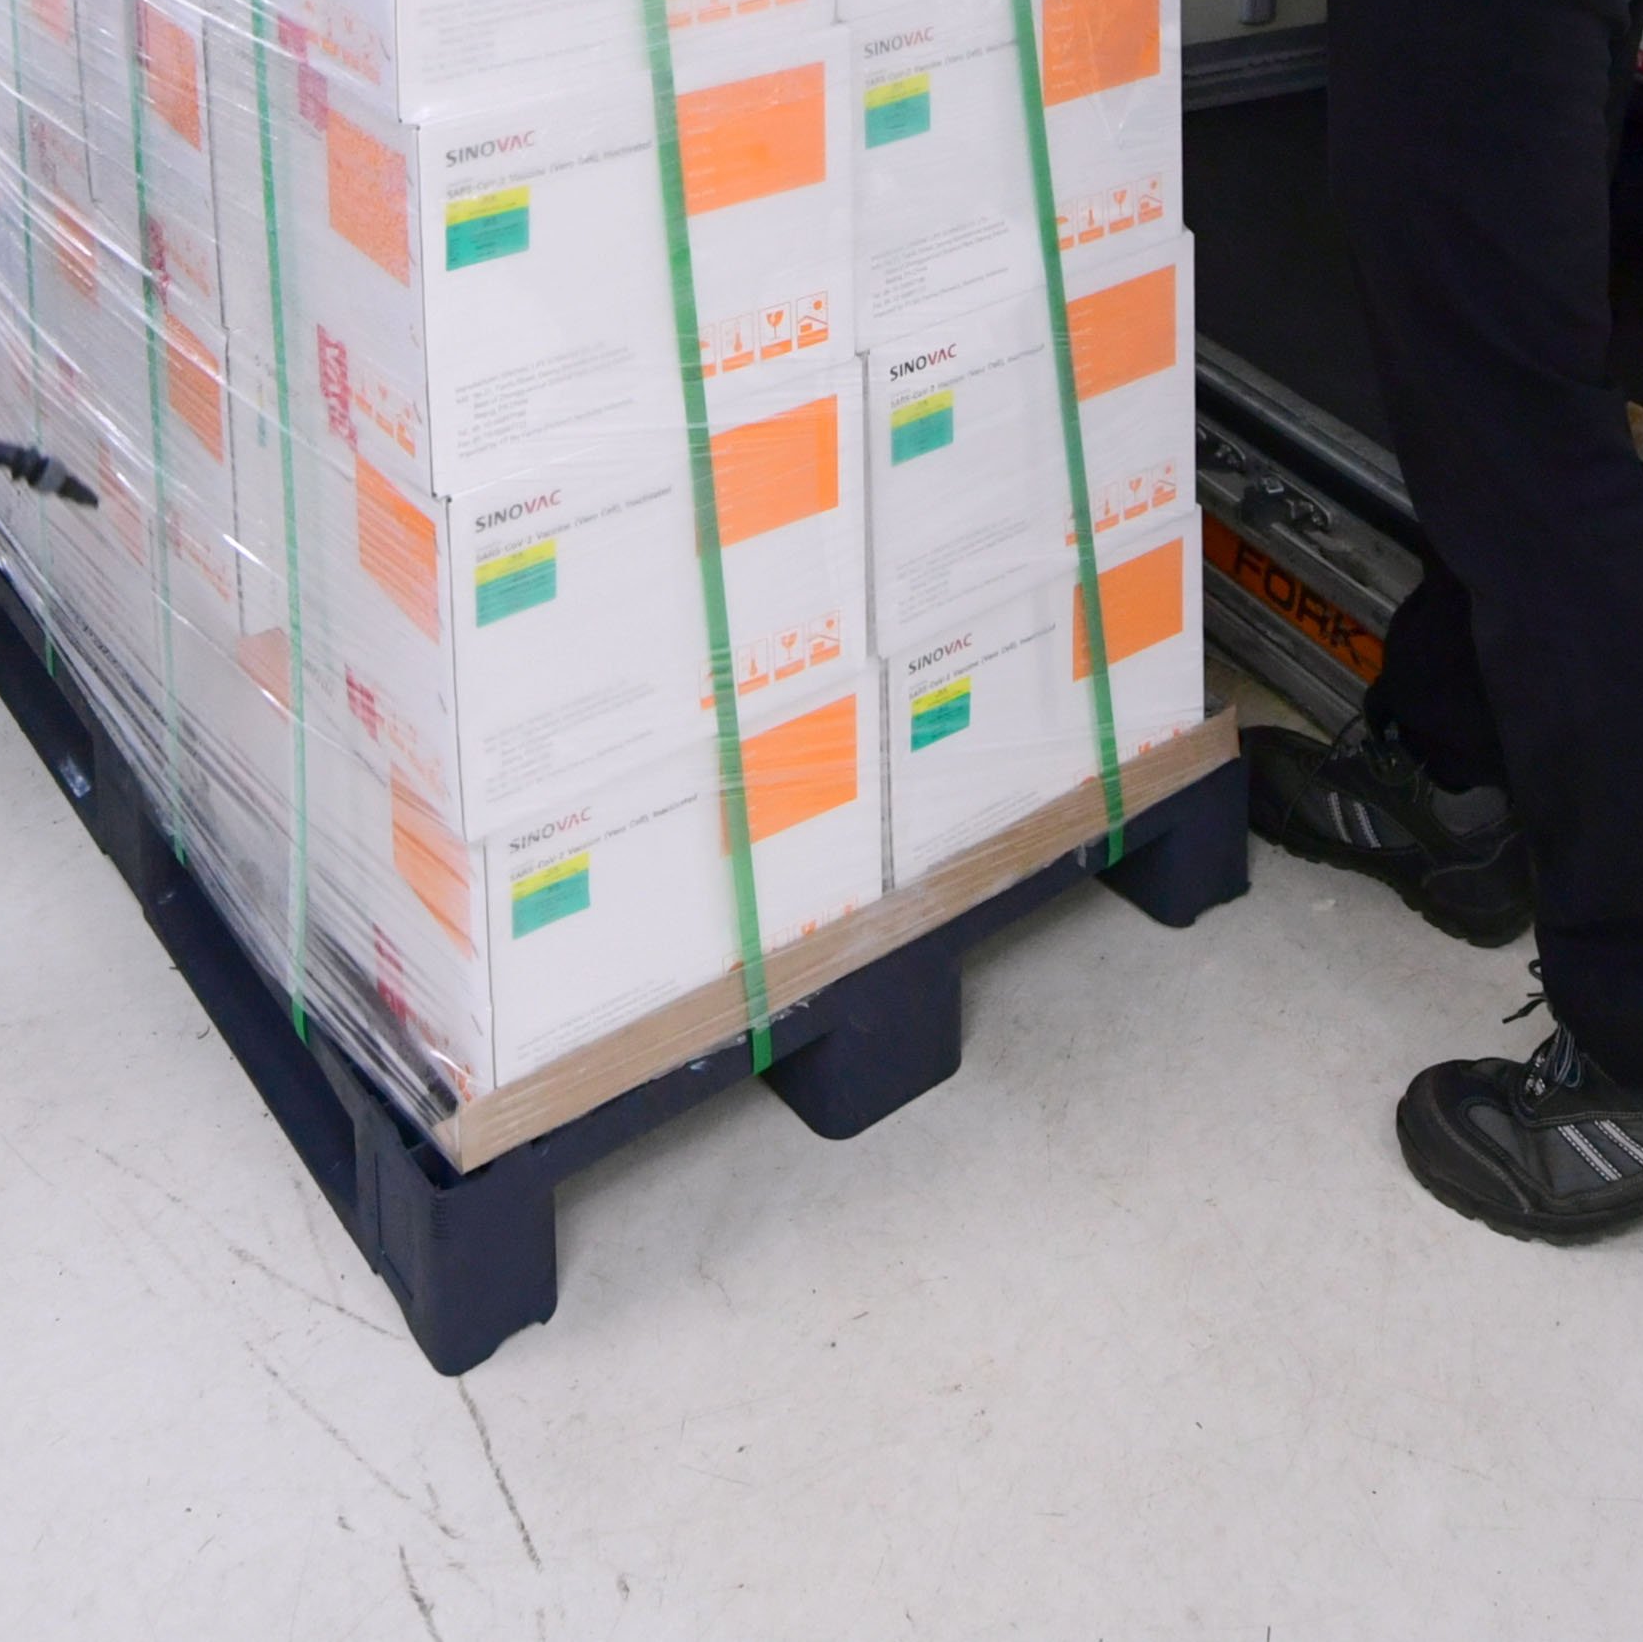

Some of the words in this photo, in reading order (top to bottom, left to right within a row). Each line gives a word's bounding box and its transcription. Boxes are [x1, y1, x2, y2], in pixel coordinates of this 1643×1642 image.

[864, 26, 934, 58] SINOVAC
[445, 130, 535, 169] SINOVAC
[889, 343, 957, 382] SINOVAC
[475, 489, 562, 533] SINOVAC
[909, 632, 973, 675] SINOVAC
[509, 806, 593, 854] SINOVAC
